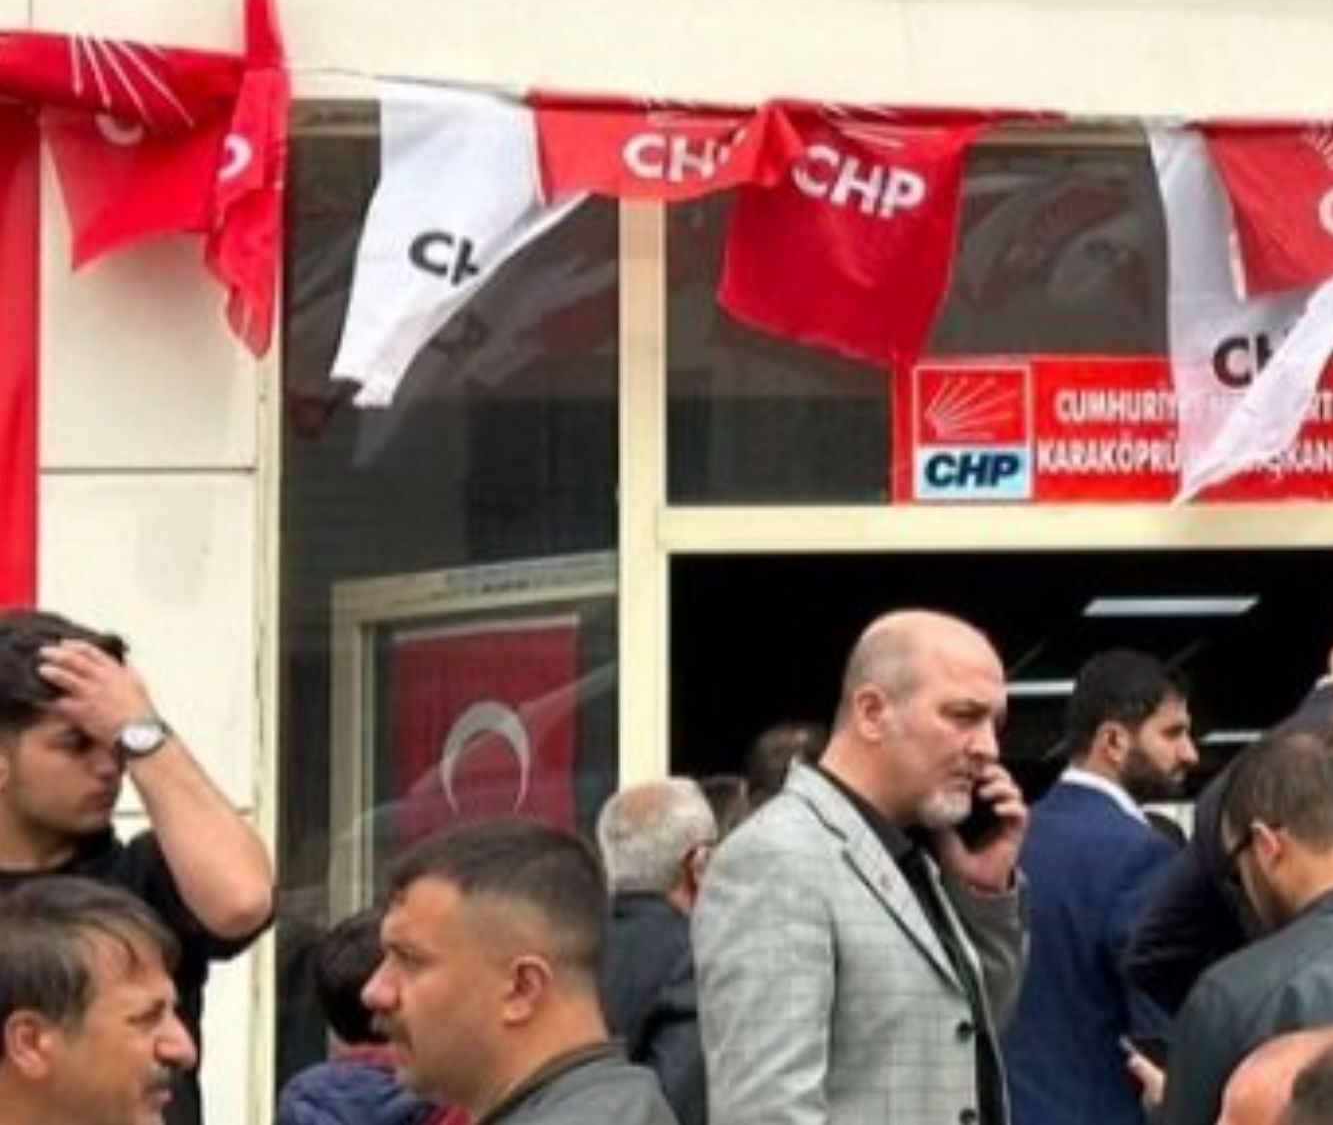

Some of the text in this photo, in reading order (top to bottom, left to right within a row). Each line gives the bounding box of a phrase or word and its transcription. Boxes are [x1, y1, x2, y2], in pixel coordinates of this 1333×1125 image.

[622, 132, 732, 182] CH
[791, 144, 926, 218] CHP
[923, 451, 1020, 490] CHP
